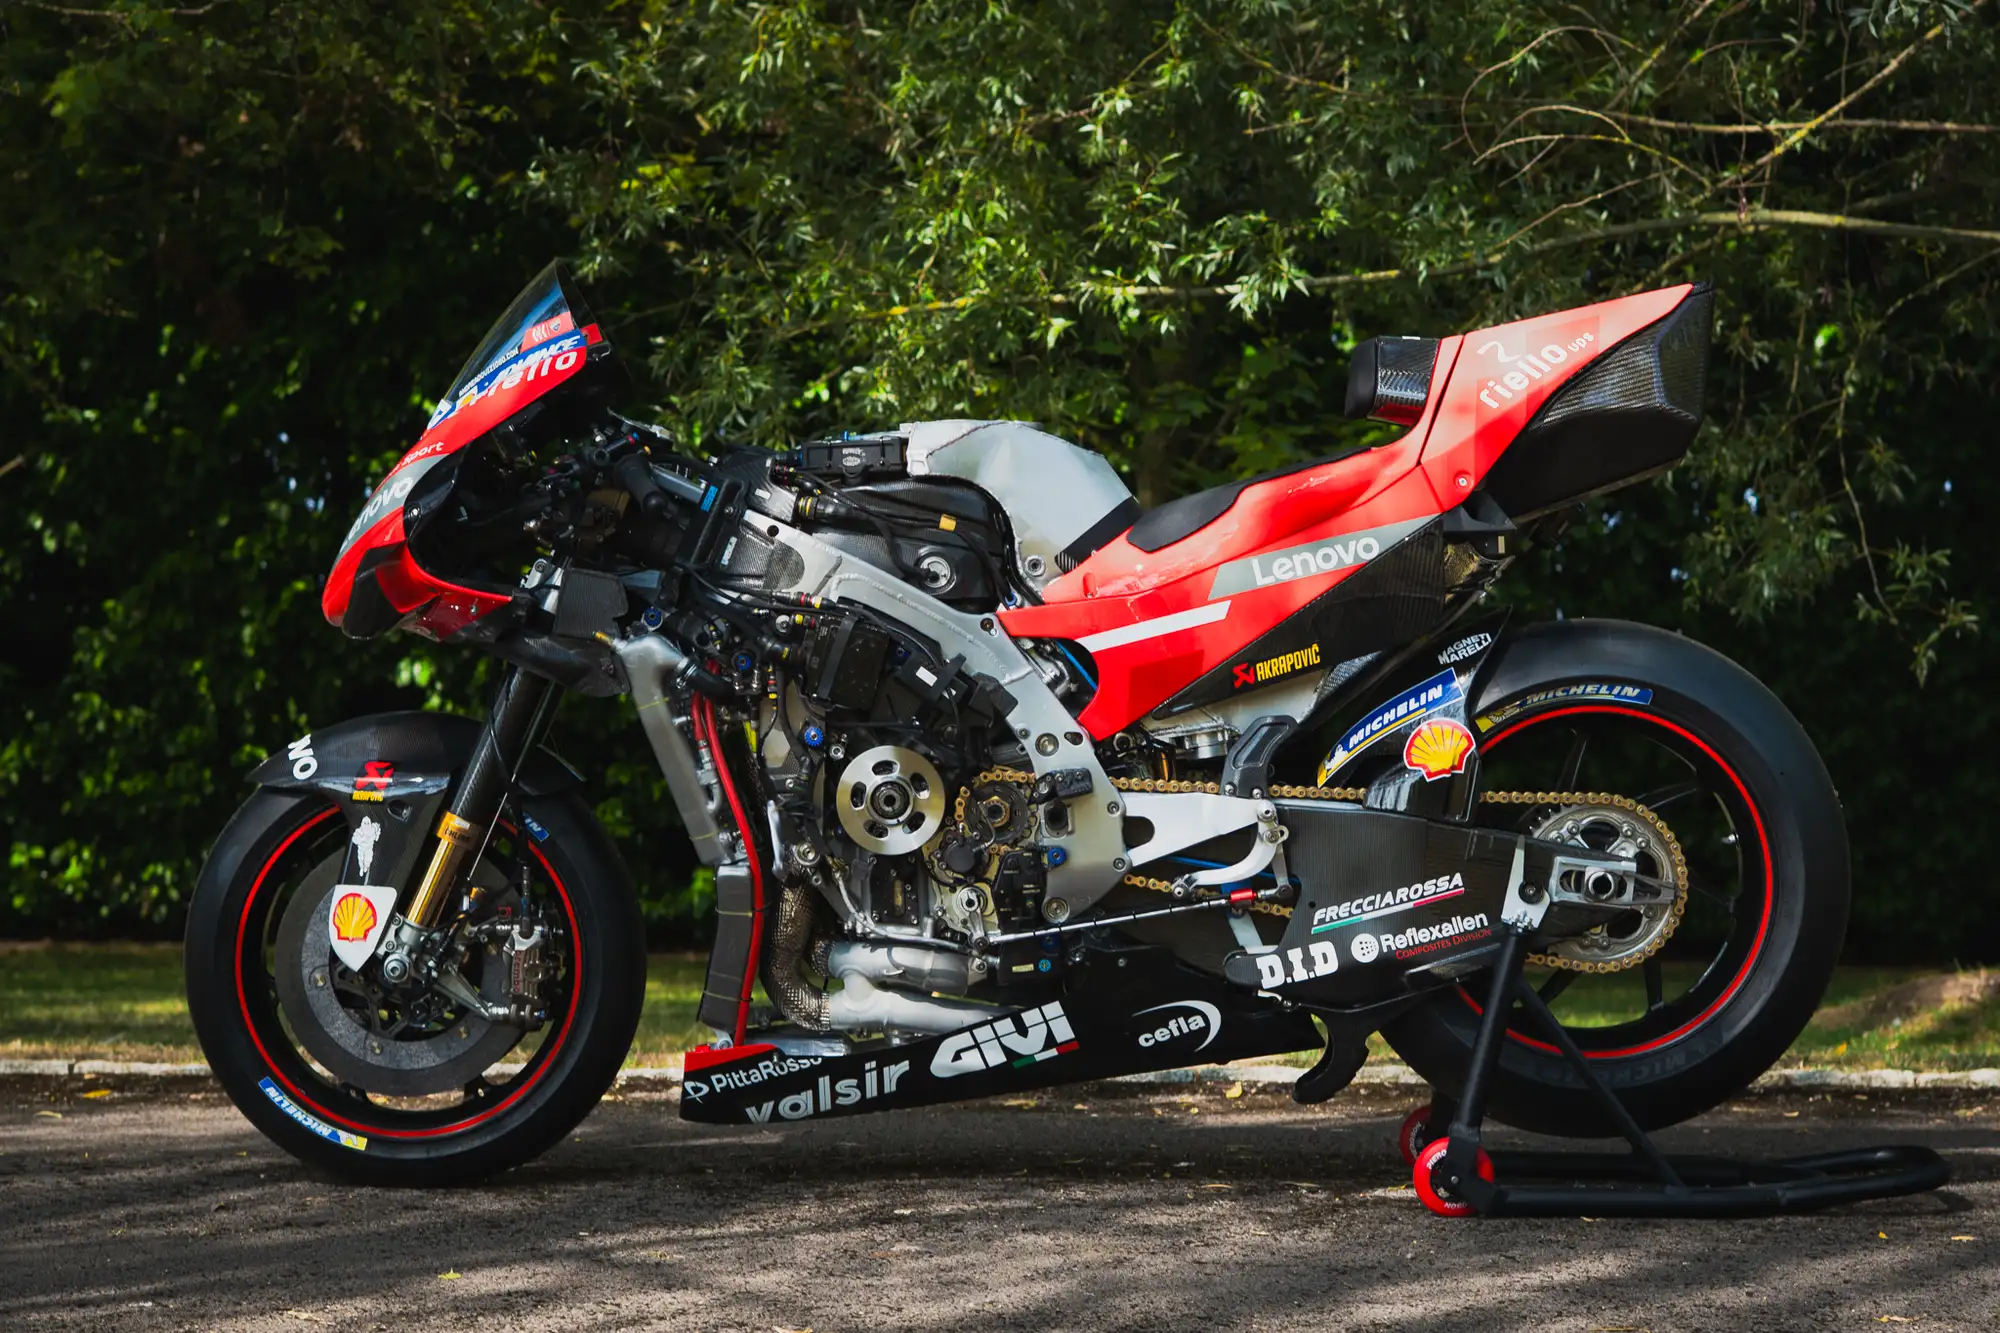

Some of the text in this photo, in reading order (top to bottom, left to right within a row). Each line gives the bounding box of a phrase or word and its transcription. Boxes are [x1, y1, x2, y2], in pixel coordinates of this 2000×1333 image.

[1480, 344, 1567, 409] riello
[402, 441, 444, 466] sport
[1252, 536, 1380, 586] Lenovo
[1348, 684, 1443, 746] MICHELIN
[1526, 684, 1640, 704] MICHELIN
[1313, 872, 1464, 926] FRECCIAROSSA
[1379, 913, 1488, 953] Reflexallen
[1395, 928, 1492, 960] COMPOSITES DIVISION
[1255, 940, 1339, 990] D.I.D
[930, 1000, 1076, 1079] GIVI
[1138, 1014, 1206, 1048] cefla
[265, 1086, 333, 1137] MICHELIN
[745, 1060, 910, 1124] valsir
